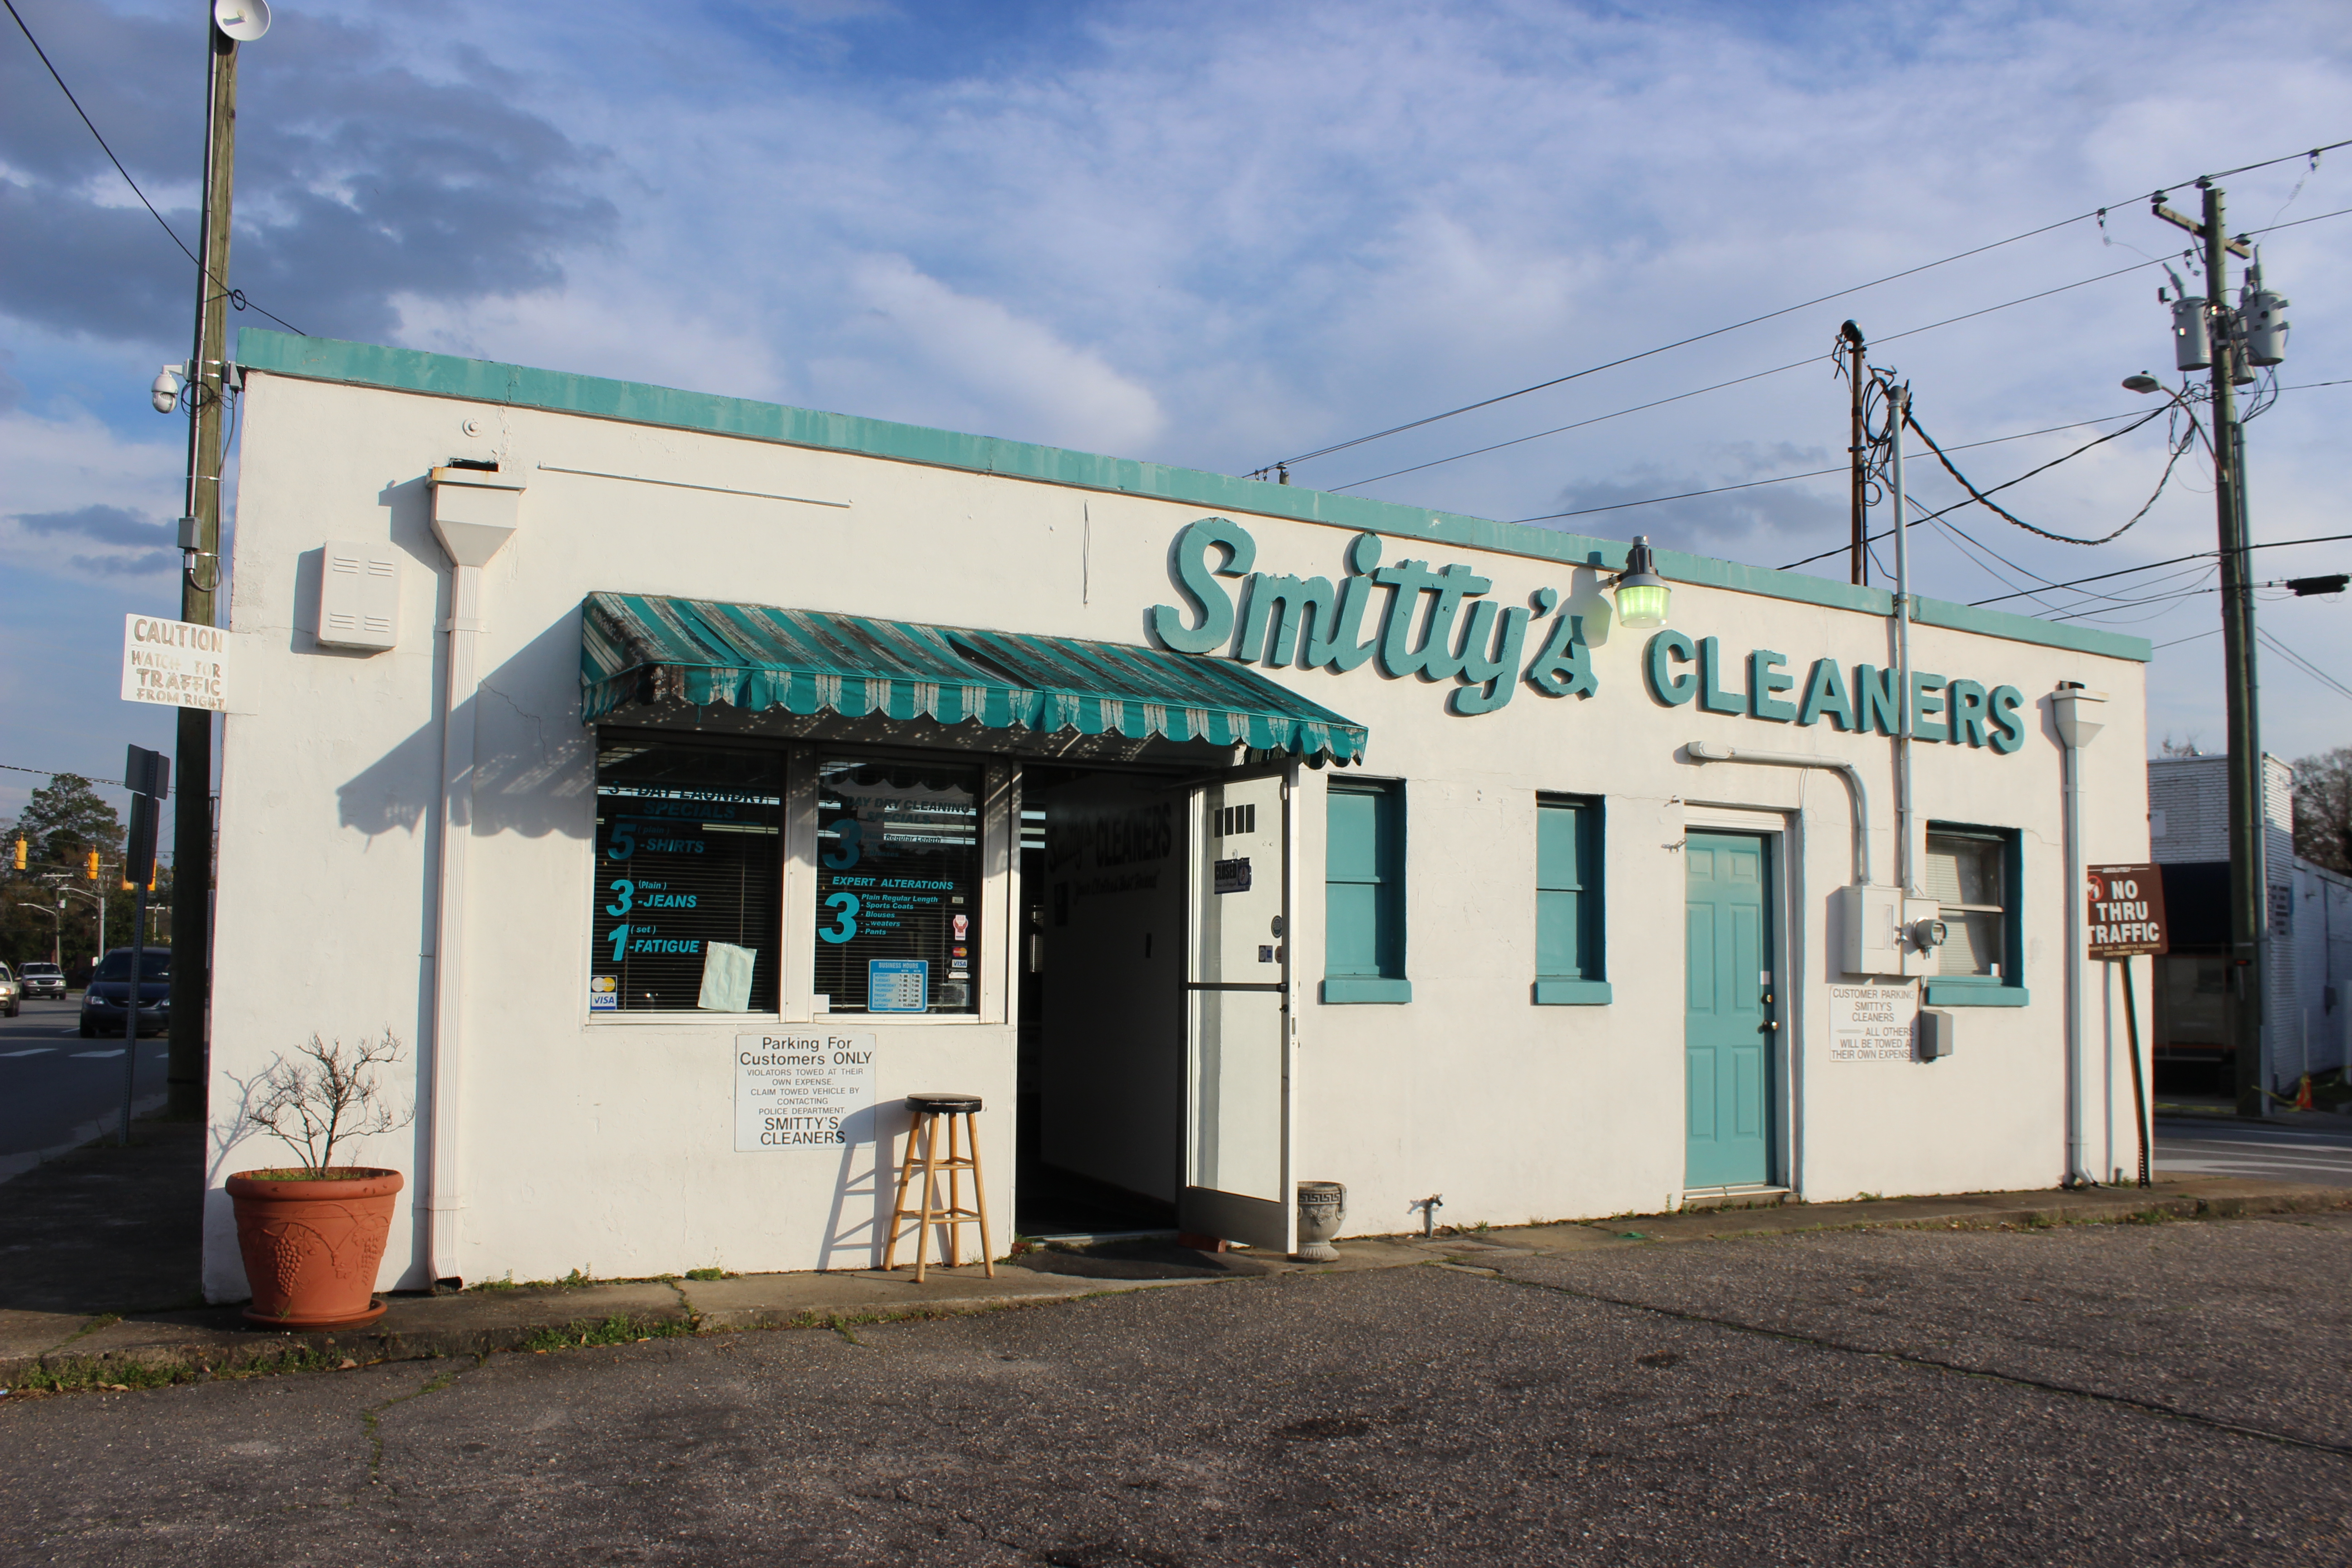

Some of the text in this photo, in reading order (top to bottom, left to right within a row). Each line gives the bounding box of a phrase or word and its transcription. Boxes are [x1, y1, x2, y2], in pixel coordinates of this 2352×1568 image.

[134, 619, 223, 653] CAUTION
[1152, 516, 2024, 754] Smitty's CLEANERS
[132, 650, 221, 678] WATCH FOR
[136, 668, 221, 696] TRAFFIC
[137, 688, 225, 710] FROM RIGHT
[643, 800, 736, 819] SPECIALS
[846, 796, 872, 807] DAY
[874, 798, 901, 809] DRY
[904, 800, 970, 813] CLEANING
[867, 812, 930, 824] SPECIALS
[607, 823, 637, 860] 5
[822, 818, 862, 870] 3
[1096, 802, 1171, 868] CLEANERS
[1215, 863, 1237, 881] CLOSED
[832, 876, 954, 890] EXPERT ALTERATIONS
[2111, 880, 2139, 899] NO
[606, 879, 634, 916] 3
[818, 892, 860, 944] 3
[2096, 902, 2148, 921] THRU
[608, 924, 629, 961] 1
[2088, 922, 2160, 944] TRAFFIC
[1833, 989, 1914, 999] CUSTOMER PARKING
[1855, 1002, 1892, 1011] SMITTY'S
[1852, 1013, 1894, 1022] CLEANERS
[1866, 1027, 1914, 1036] ALL OTHERS
[763, 1036, 852, 1052] Parking For
[1840, 1039, 1914, 1048] WILL BE TOWED AT
[740, 1051, 872, 1065] Customers ONLY
[1832, 1050, 1914, 1059] THEIR OWN EXPENSE
[764, 1117, 839, 1131] SMITTY'S
[760, 1131, 845, 1145] CLEANERS
